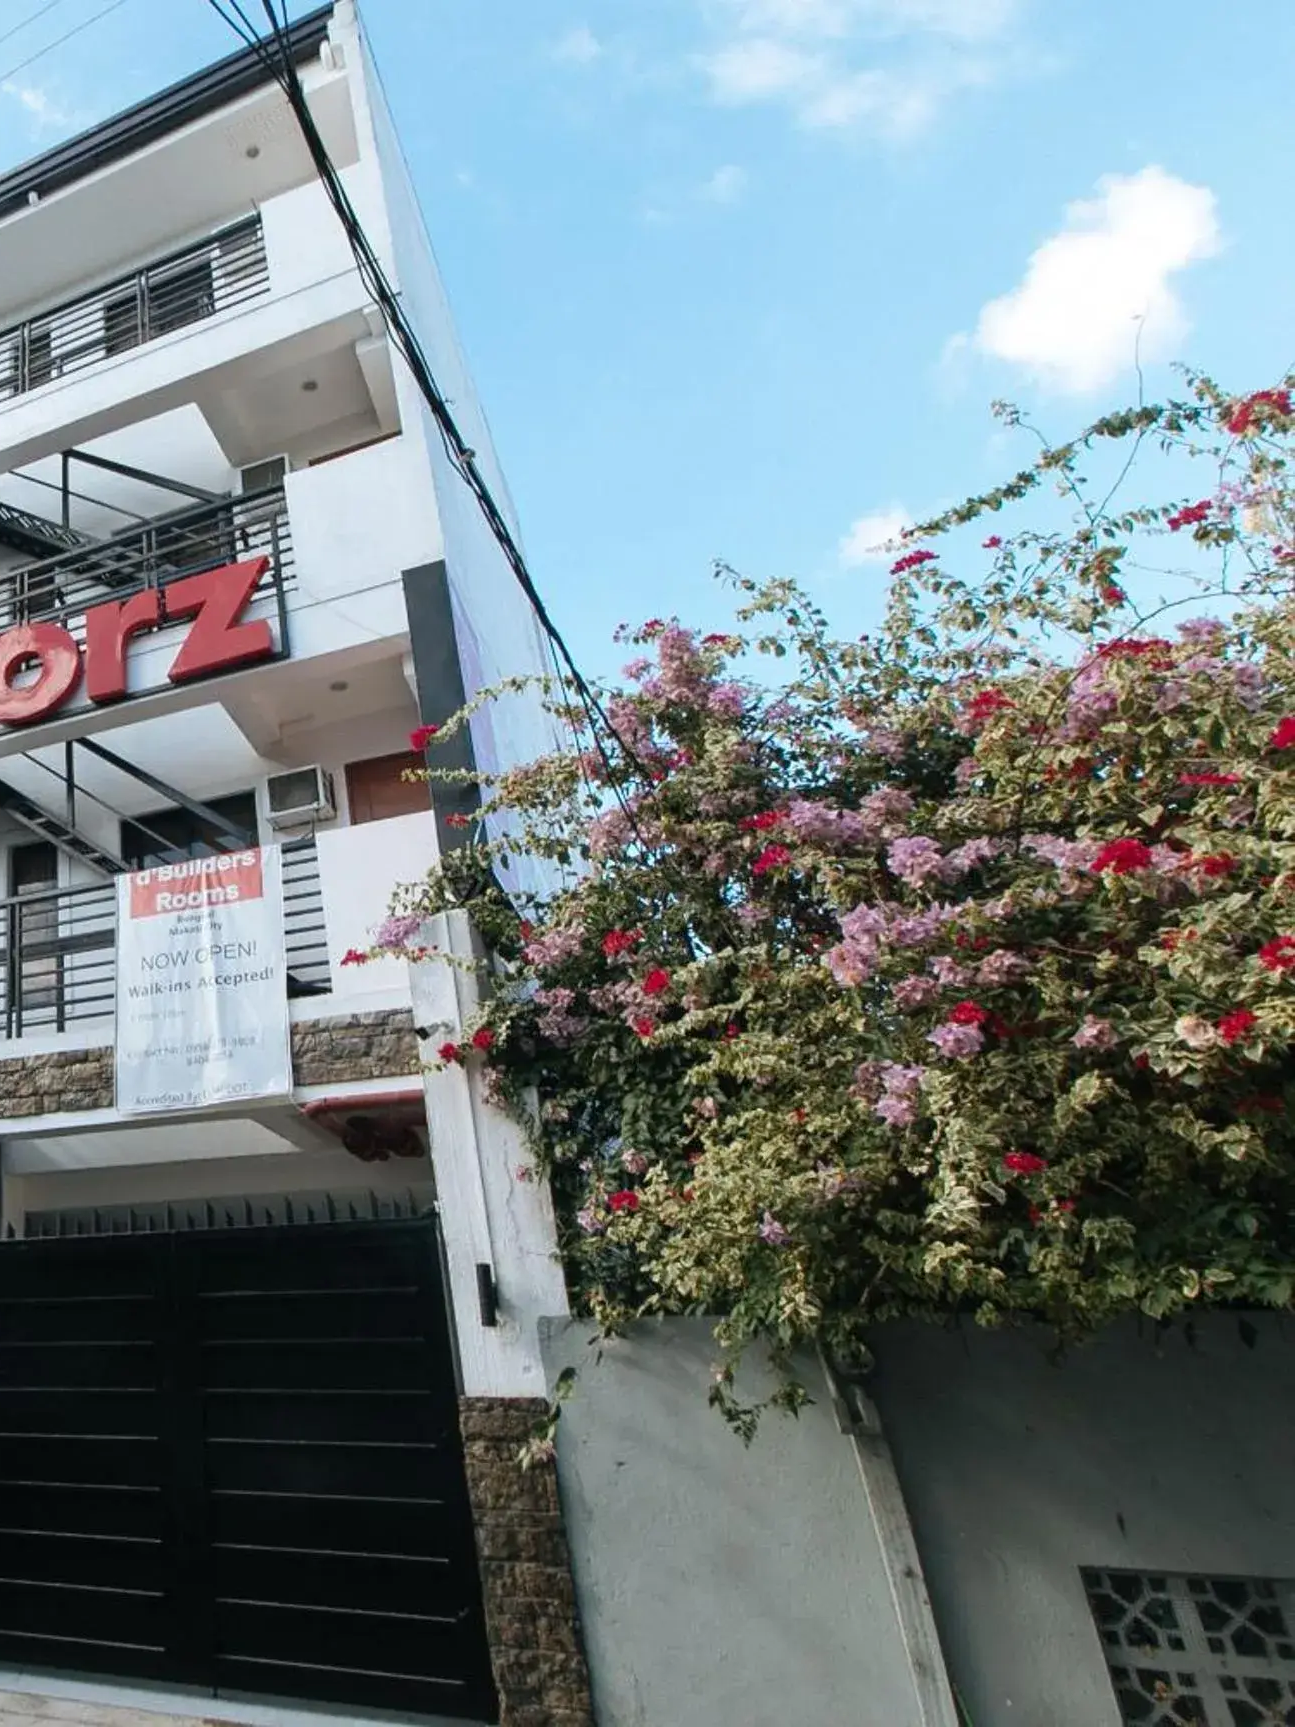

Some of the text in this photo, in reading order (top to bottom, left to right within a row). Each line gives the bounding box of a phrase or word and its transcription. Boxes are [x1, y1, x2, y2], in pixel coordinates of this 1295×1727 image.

[136, 851, 255, 885] d'Builders
[156, 884, 240, 911] Rooms
[141, 940, 257, 971] NOW OPEN!
[128, 967, 275, 999] Walk-ins Accepted!
